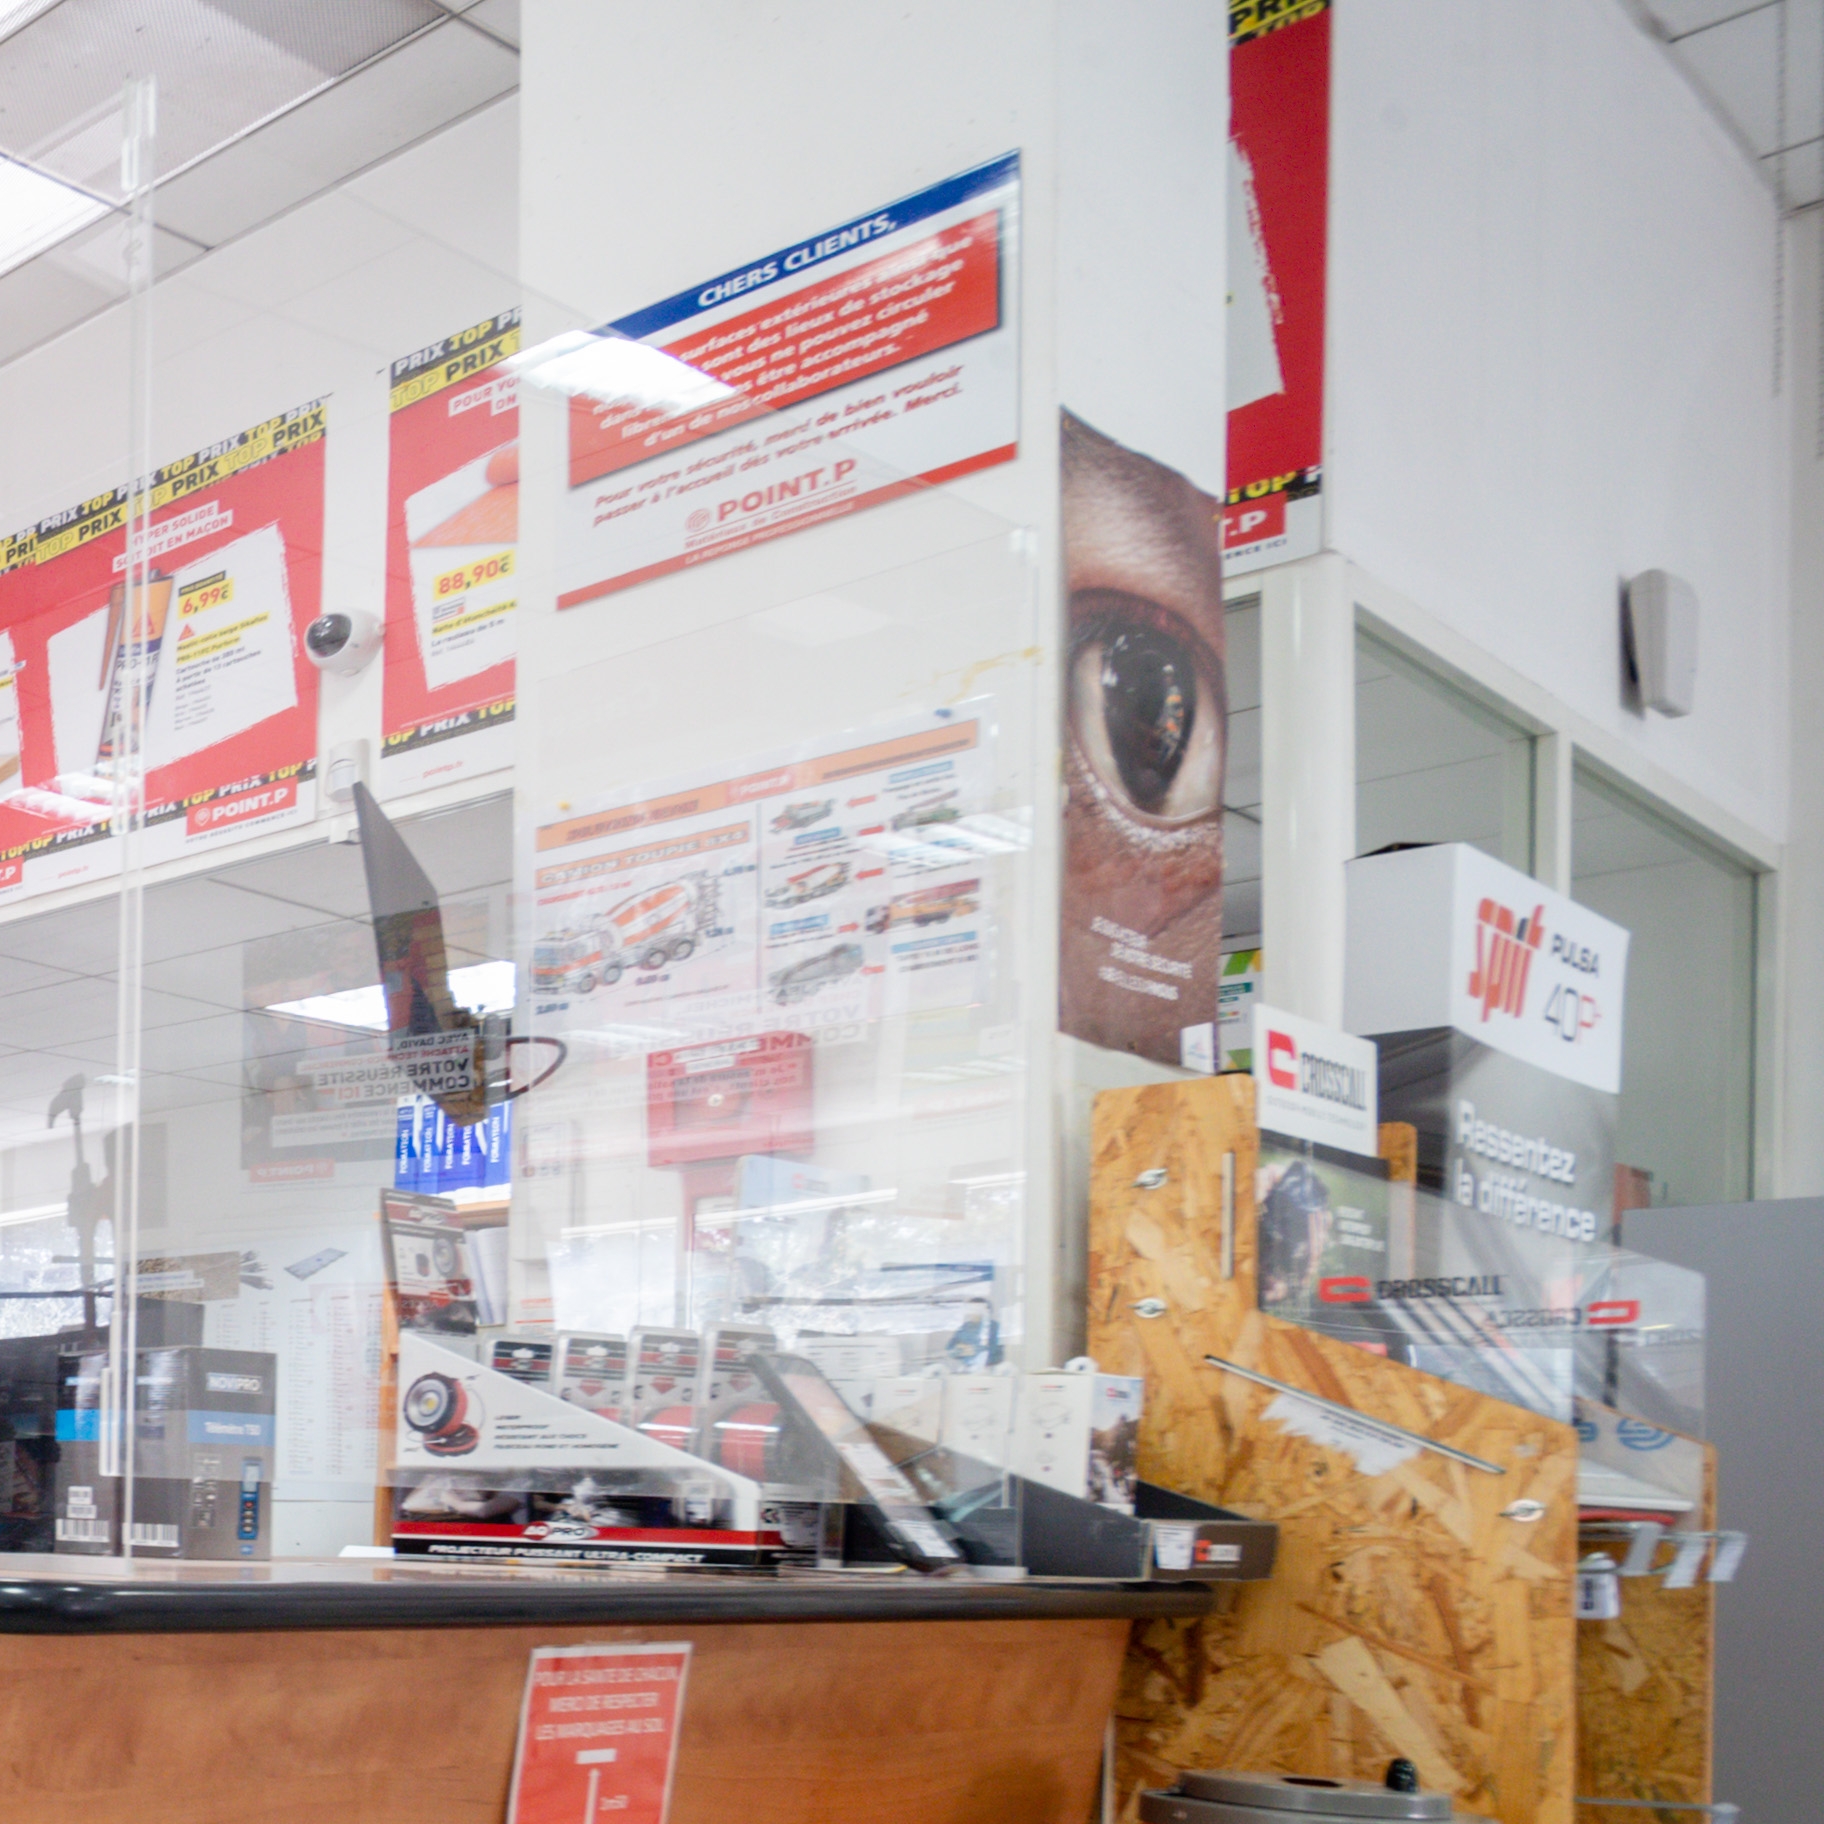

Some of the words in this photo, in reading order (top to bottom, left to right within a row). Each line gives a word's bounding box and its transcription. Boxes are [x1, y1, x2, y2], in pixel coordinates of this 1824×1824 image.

[698, 263, 778, 307] CHERS
[782, 213, 897, 272] CLIENTS,
[759, 279, 873, 330] extérieures
[785, 311, 835, 338] lieux
[838, 299, 865, 317] de
[868, 259, 964, 305] stockage
[798, 314, 873, 354] pouvez
[875, 281, 955, 321] circuler
[394, 342, 445, 375] PRIX
[451, 322, 492, 350] TOP
[446, 339, 504, 382] PRIX
[756, 362, 797, 386] être
[799, 310, 929, 368] accompagné
[161, 455, 194, 480] TOP
[199, 435, 240, 464] PRIX
[717, 458, 858, 523] POINT.P
[172, 507, 215, 529] SOLIDE
[186, 516, 228, 541] MAÇON
[212, 787, 288, 823] POINT.P
[1550, 934, 1600, 979] PULSA
[490, 1116, 500, 1163] FORMATION
[1456, 1158, 1473, 1206] la
[1478, 1174, 1598, 1243] différence
[428, 1544, 513, 1557] PROJECTEUR
[515, 1547, 581, 1560] PUISSANT
[584, 1550, 705, 1564] ULTRA-COMPACT
